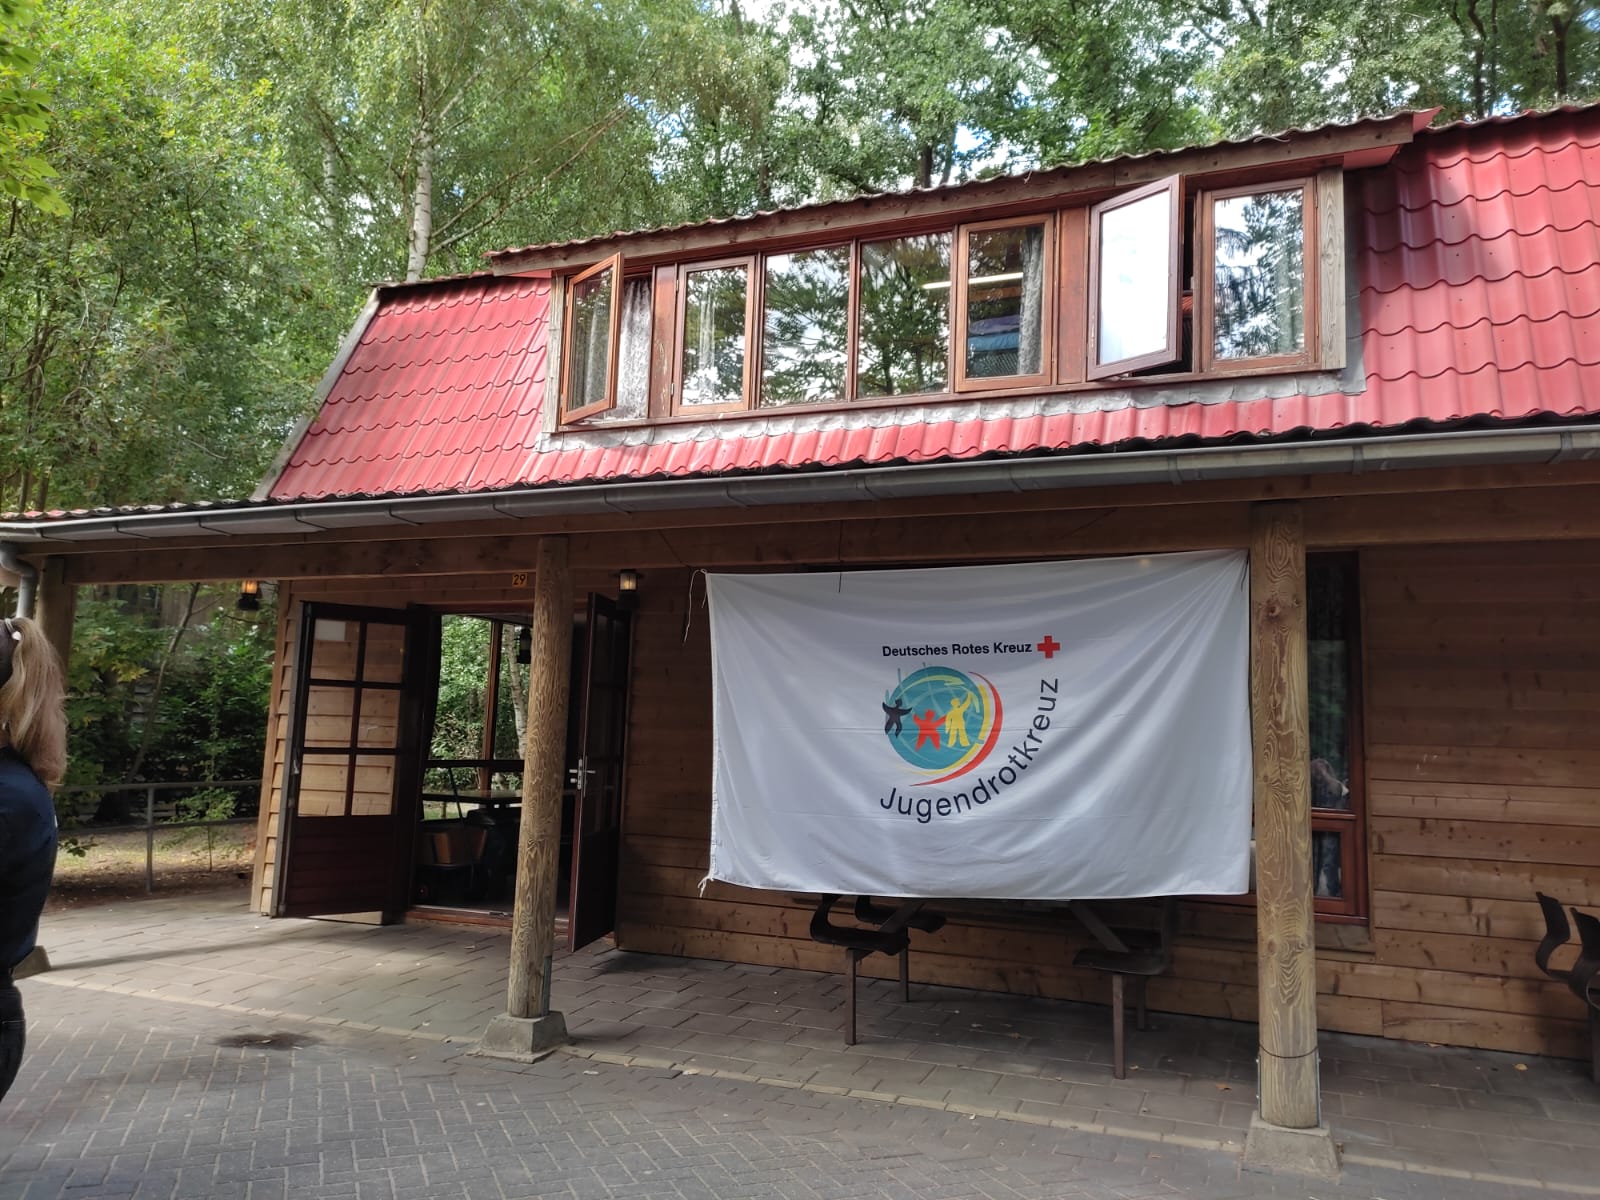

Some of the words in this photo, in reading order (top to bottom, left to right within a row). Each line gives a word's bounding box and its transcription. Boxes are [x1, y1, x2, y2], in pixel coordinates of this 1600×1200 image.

[513, 574, 526, 586] 29
[882, 644, 948, 657] Deutsches
[951, 643, 990, 655] Rotes
[993, 642, 1032, 654] Kreuz
[880, 678, 1059, 824] Jugendrotkreuz
